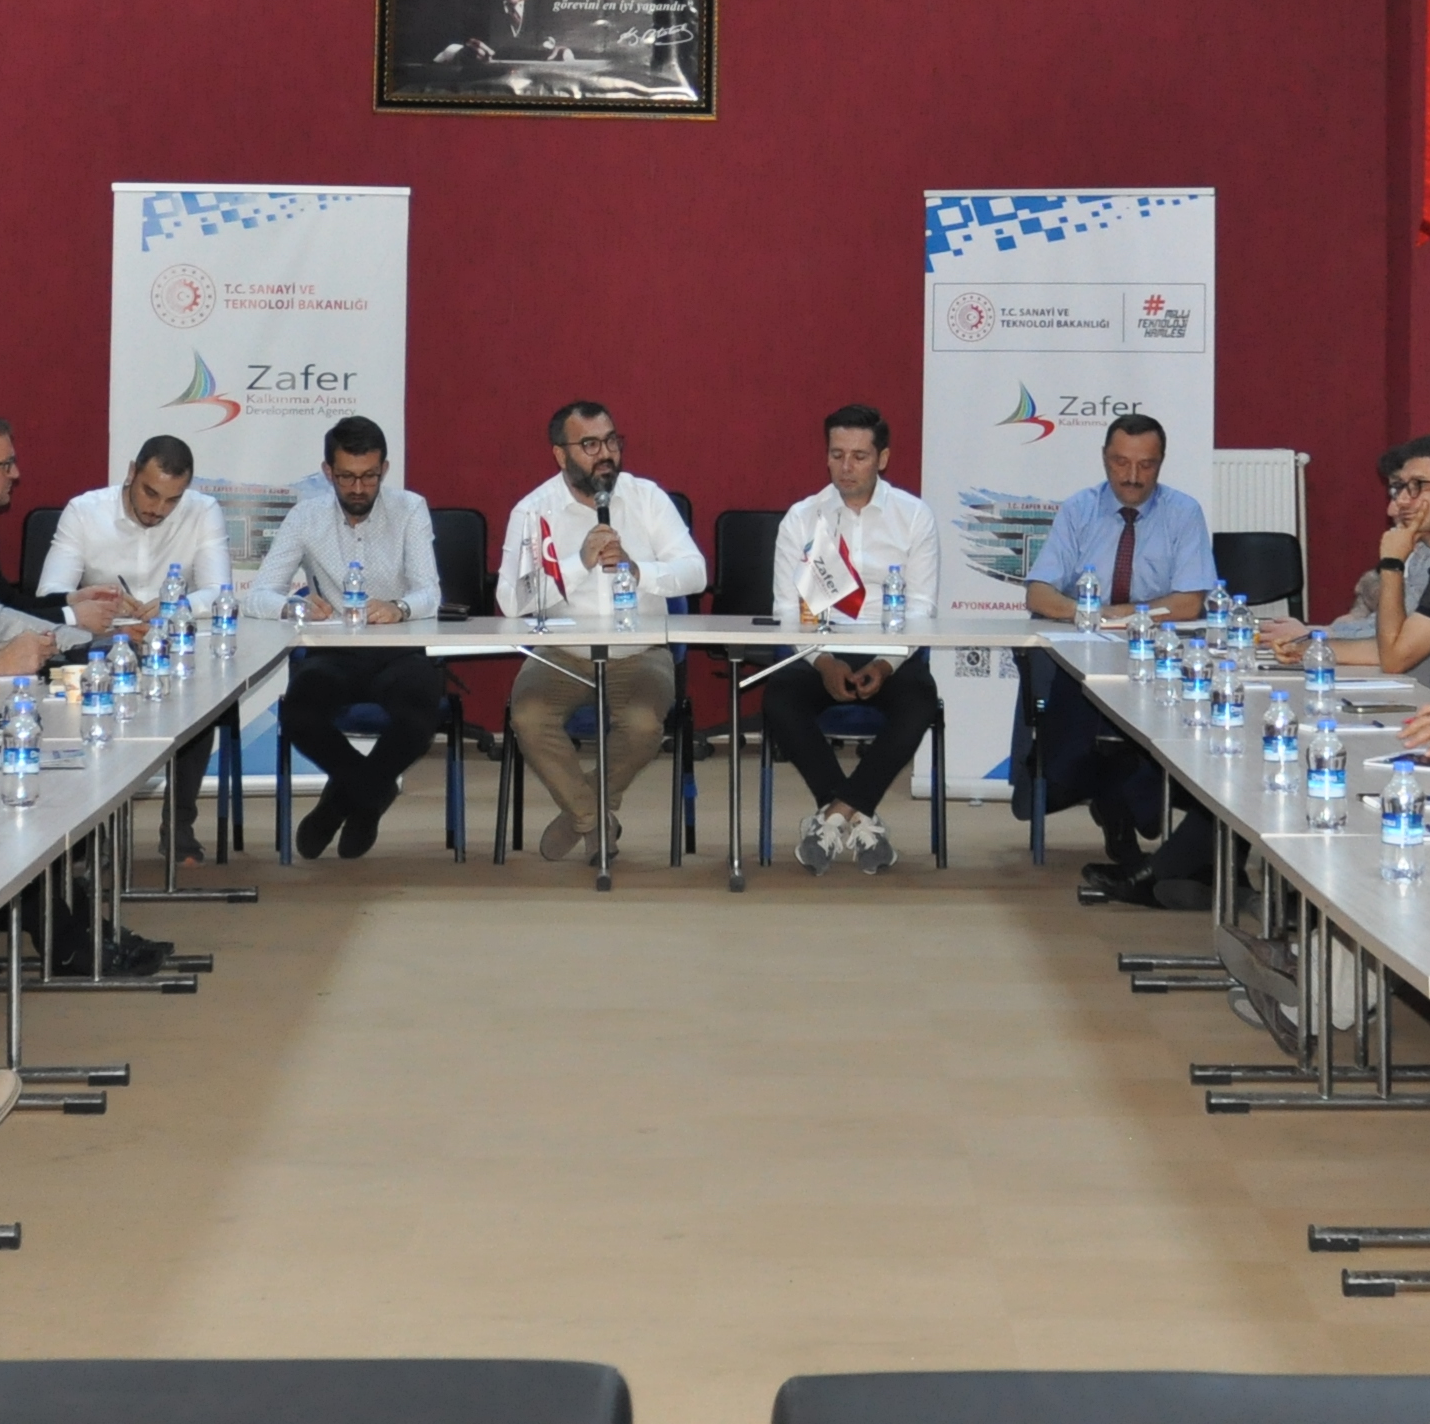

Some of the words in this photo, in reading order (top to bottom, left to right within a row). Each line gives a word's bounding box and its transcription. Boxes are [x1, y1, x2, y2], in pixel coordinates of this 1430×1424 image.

[602, 2, 617, 11] en
[619, 0, 635, 14] iyi
[224, 283, 246, 295] T.C.
[249, 281, 296, 295] SANAYİ
[299, 284, 315, 295] VE
[224, 298, 294, 310] TEKNOLOJİ
[297, 299, 368, 311] BAKANLIĞI
[1000, 307, 1017, 317] T.C.
[1019, 306, 1055, 317] SANAYİ
[1057, 308, 1070, 317] VE
[1000, 319, 1054, 329] TEKNOLOJİ
[1056, 319, 1110, 329] BAKANLIĞI
[246, 363, 358, 391] Zafer
[246, 394, 310, 404] Kalkınma
[314, 394, 357, 407] Ajansı
[1059, 395, 1142, 417] Zafer
[245, 405, 315, 416] Development
[317, 406, 357, 418] Agency
[813, 556, 839, 593] Zafer
